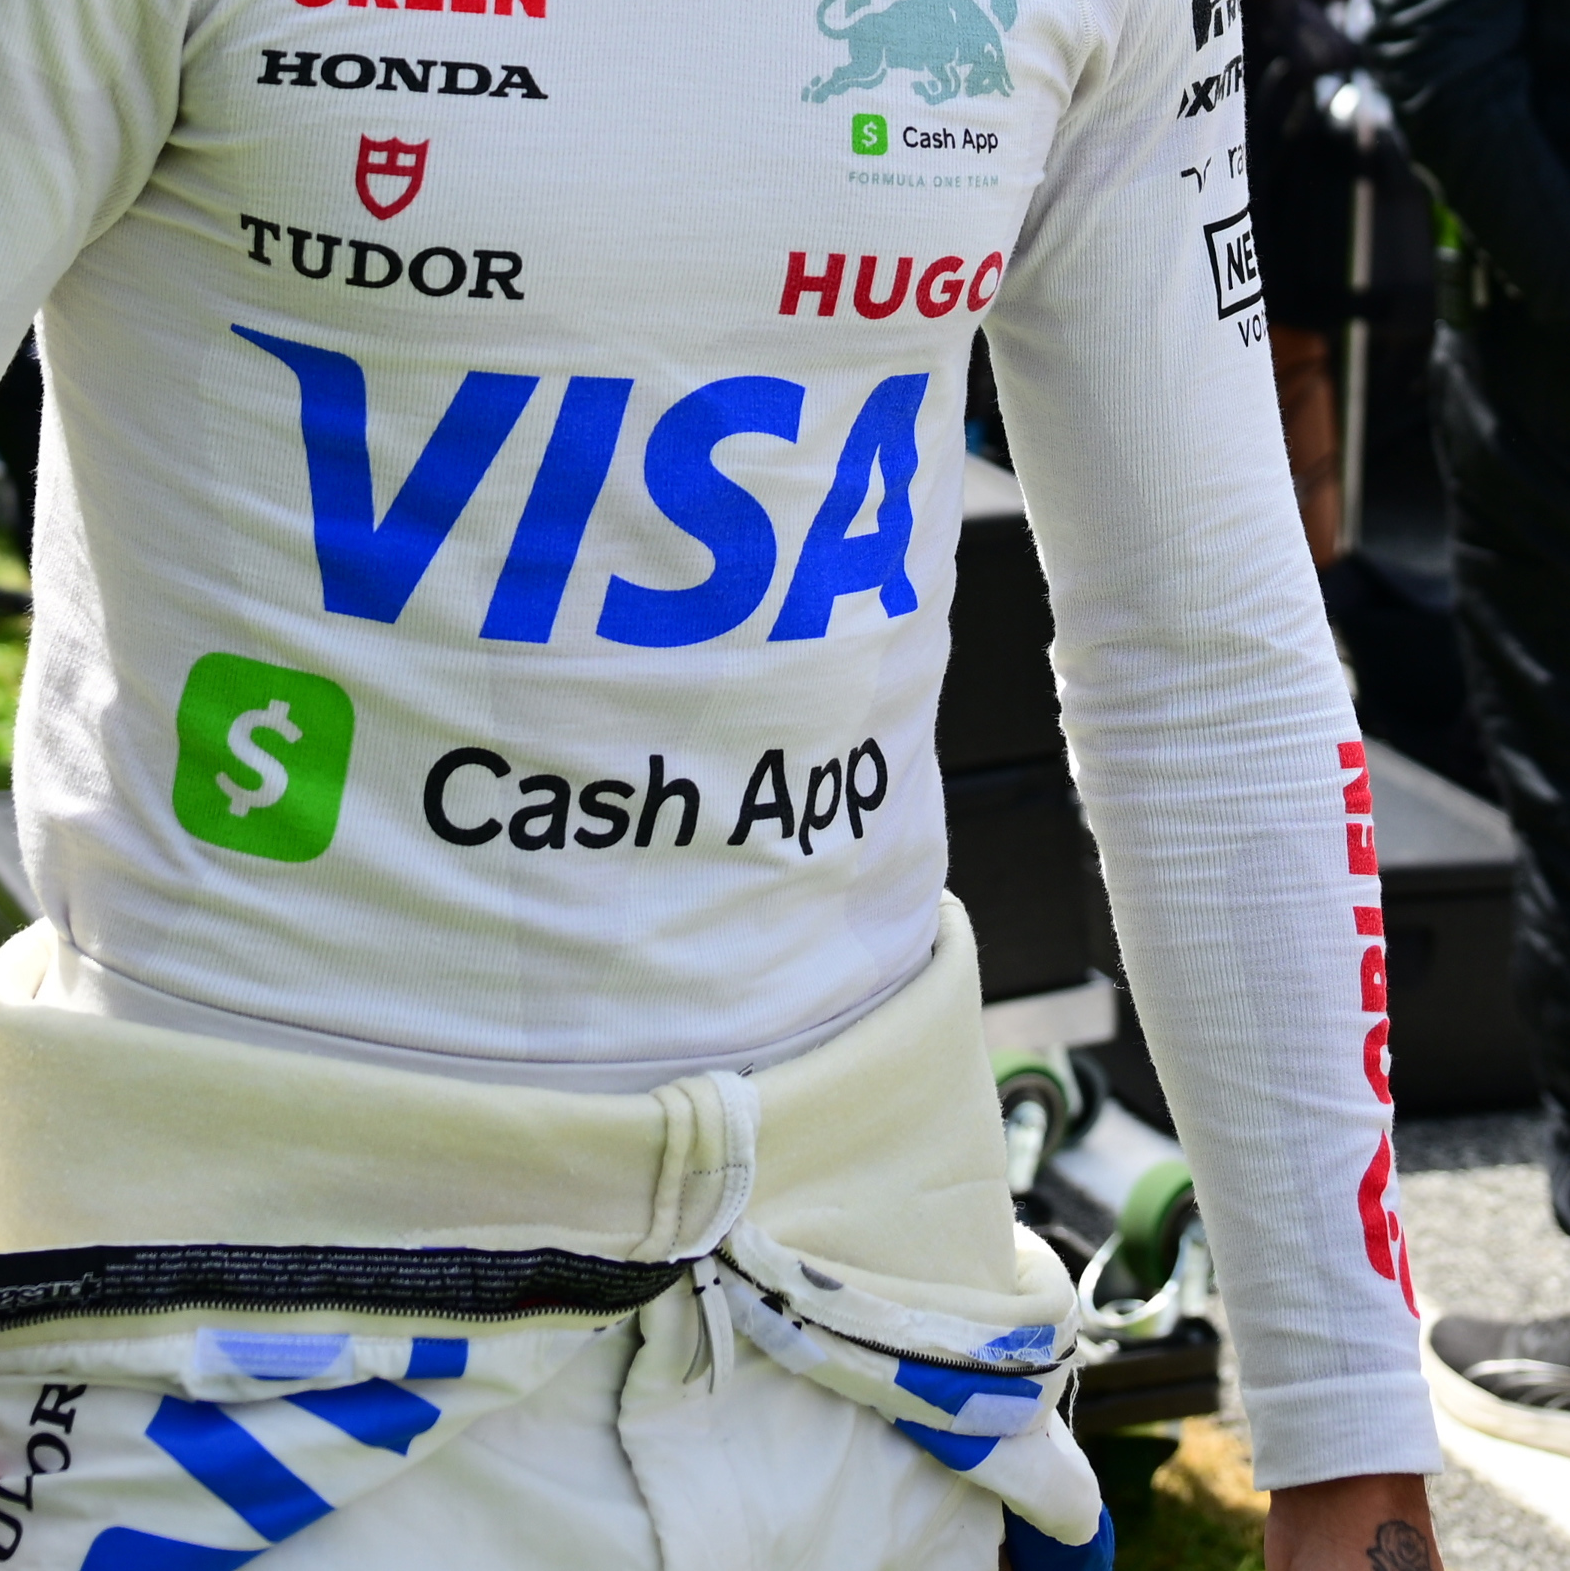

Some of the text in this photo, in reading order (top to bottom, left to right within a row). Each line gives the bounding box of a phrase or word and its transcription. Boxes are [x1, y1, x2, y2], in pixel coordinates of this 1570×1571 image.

[257, 49, 549, 100] HONDA
[902, 125, 956, 149] Cash
[962, 127, 999, 154] App
[849, 171, 999, 188] FORMULA ONE TEAM
[240, 213, 525, 300] TUDOR
[778, 250, 1004, 319] HUGO
[1237, 312, 1267, 348] VO
[230, 323, 931, 648] VISA
[422, 745, 702, 851] Cash
[728, 735, 889, 857] App
